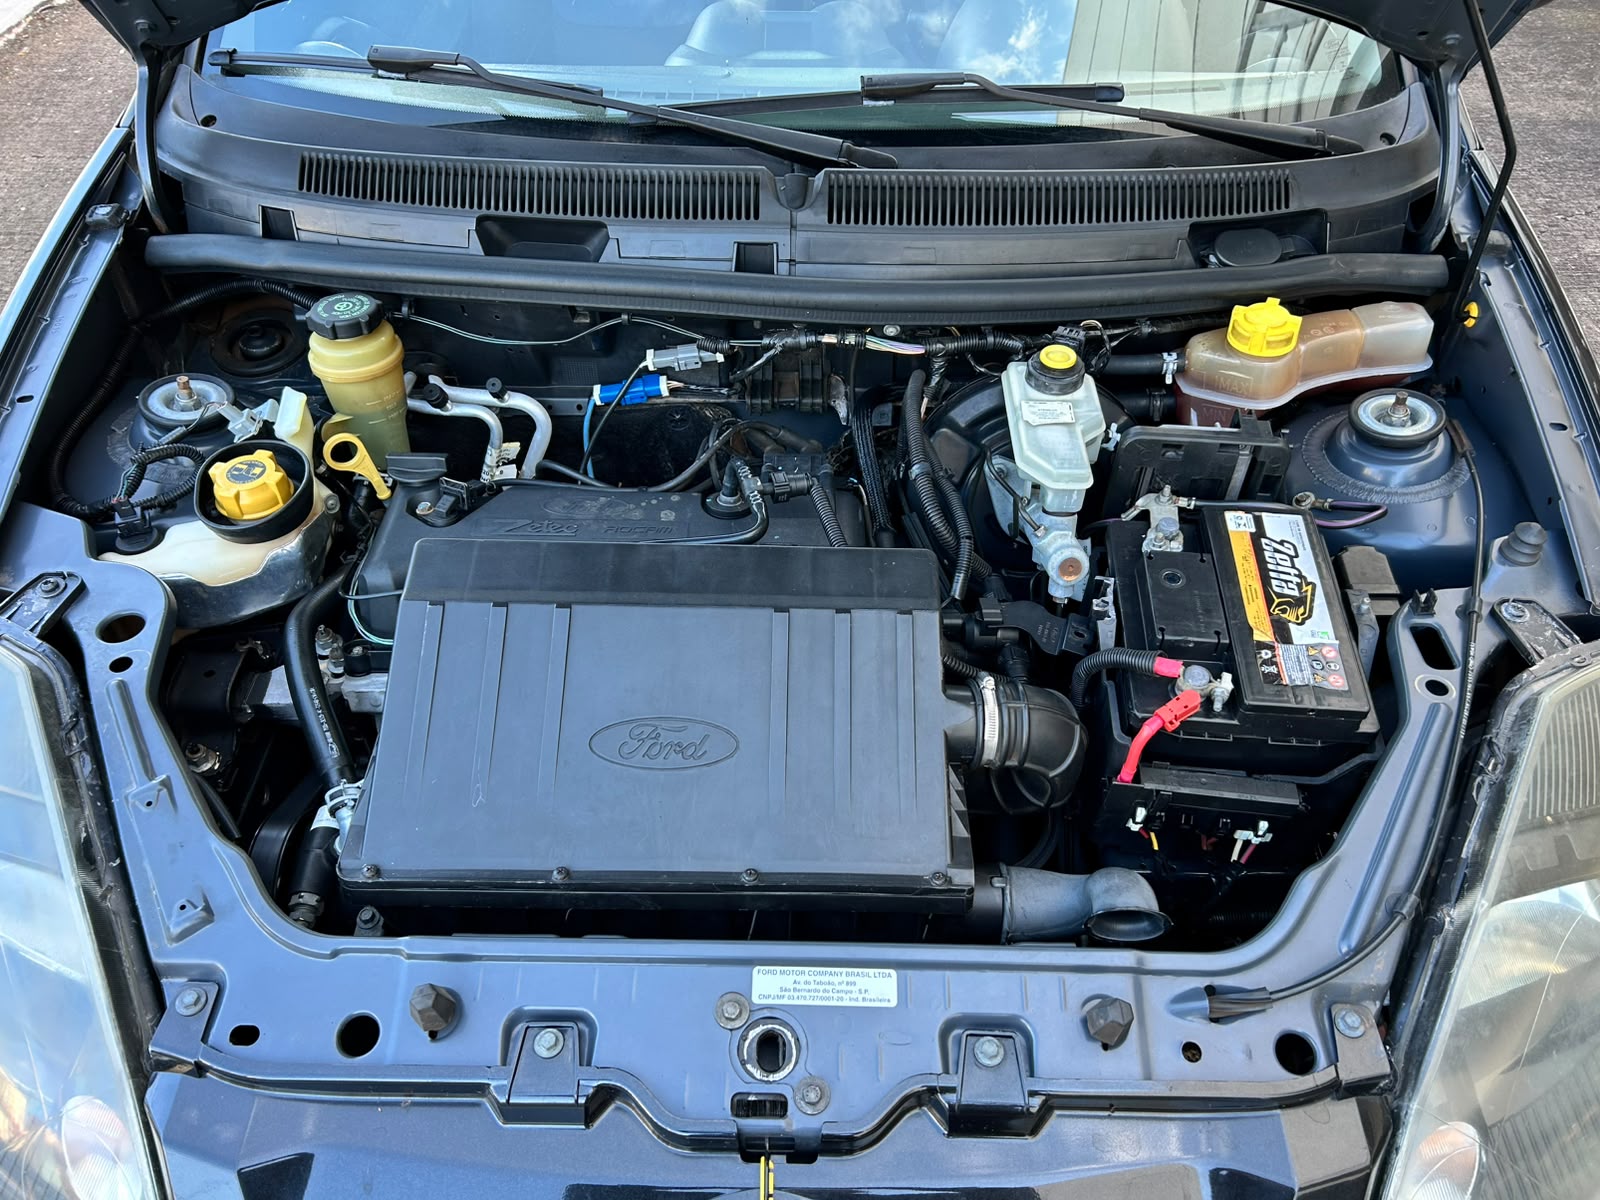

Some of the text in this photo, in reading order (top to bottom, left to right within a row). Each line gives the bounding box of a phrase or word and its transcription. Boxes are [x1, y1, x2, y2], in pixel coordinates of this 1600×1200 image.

[1219, 376, 1250, 394] MAX
[505, 519, 579, 537] Zetec
[1261, 536, 1301, 597] Zetta
[618, 722, 710, 761] Ford
[757, 968, 893, 979] FORD MOTOR COMPANY BRASIL LTDA
[792, 986, 821, 994] Bernardo
[831, 987, 854, 995] Campo
